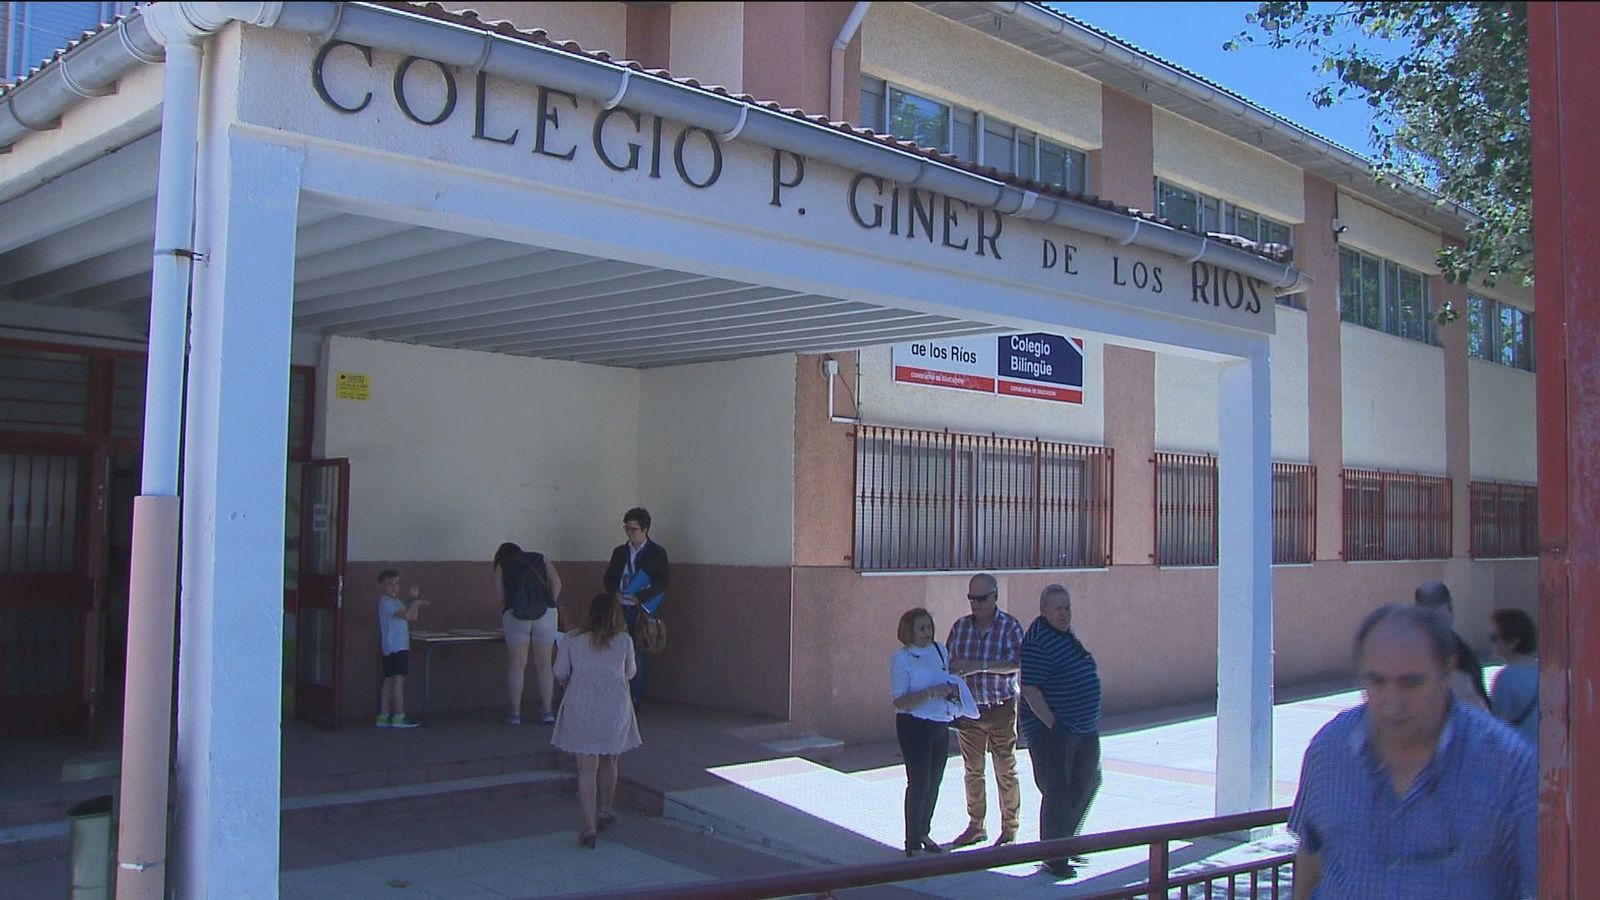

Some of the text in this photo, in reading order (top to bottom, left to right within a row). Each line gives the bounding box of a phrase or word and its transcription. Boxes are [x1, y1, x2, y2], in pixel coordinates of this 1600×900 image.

[312, 41, 1262, 314] COLEGIO P. GINER DE LOS RIOS
[911, 342, 977, 364] de los Ríos
[1010, 335, 1051, 358] Colegio
[1010, 355, 1053, 377] Bilingüe
